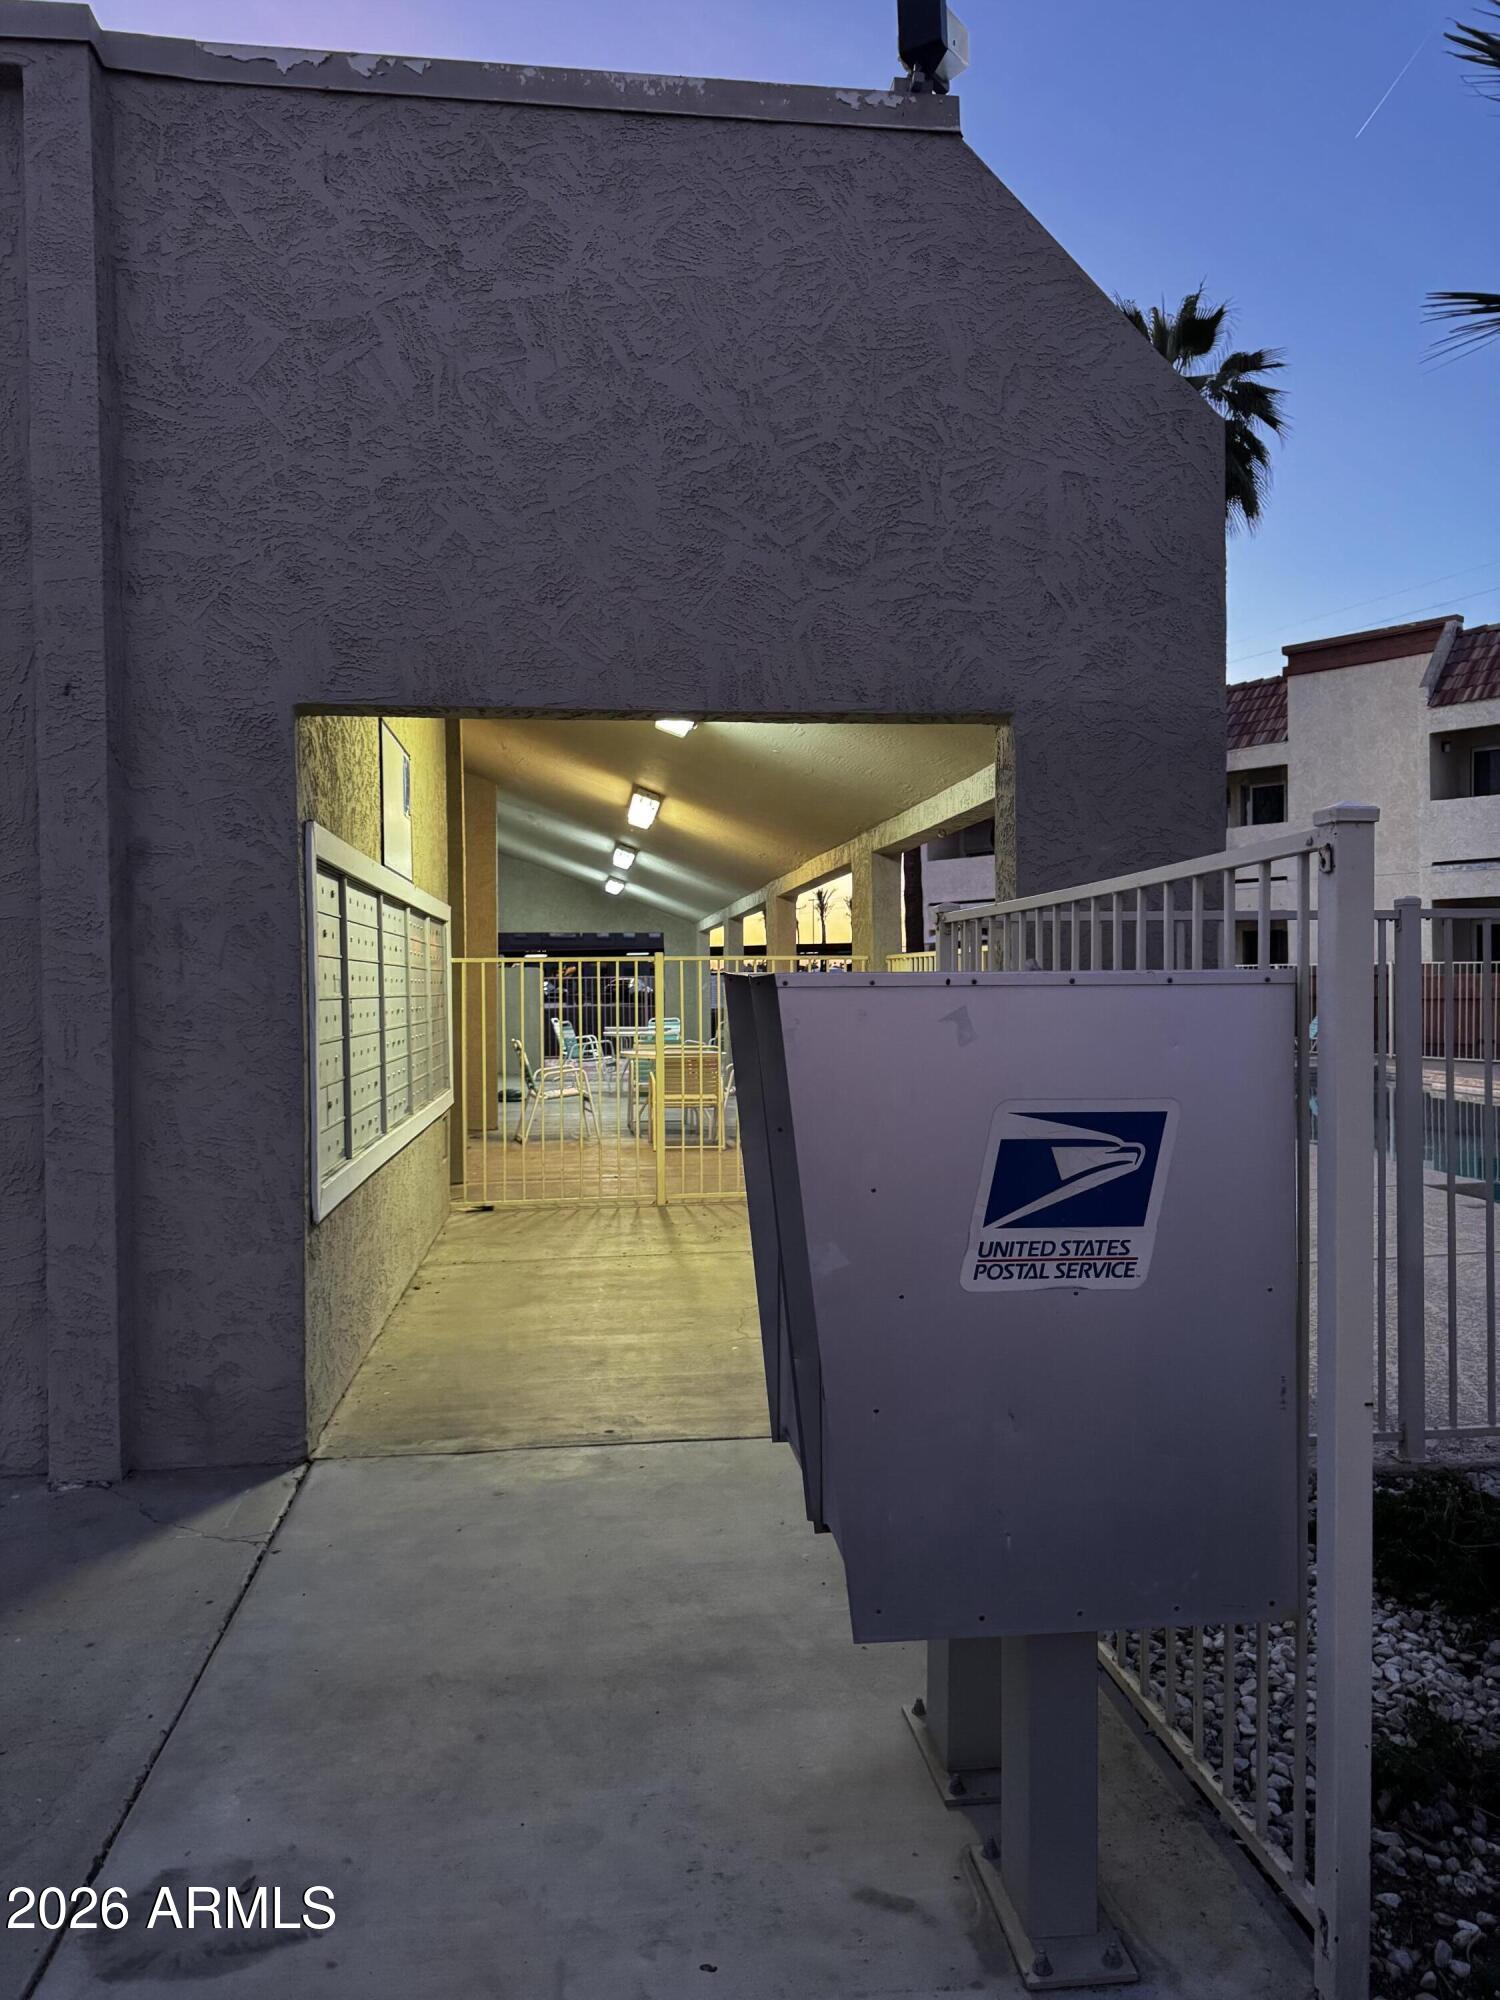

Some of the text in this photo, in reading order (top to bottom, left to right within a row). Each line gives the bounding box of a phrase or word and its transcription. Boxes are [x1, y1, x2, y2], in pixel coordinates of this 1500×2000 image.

[978, 1239, 1132, 1258] UNITED STATES
[973, 1261, 1138, 1280] POSTAL SERVICE
